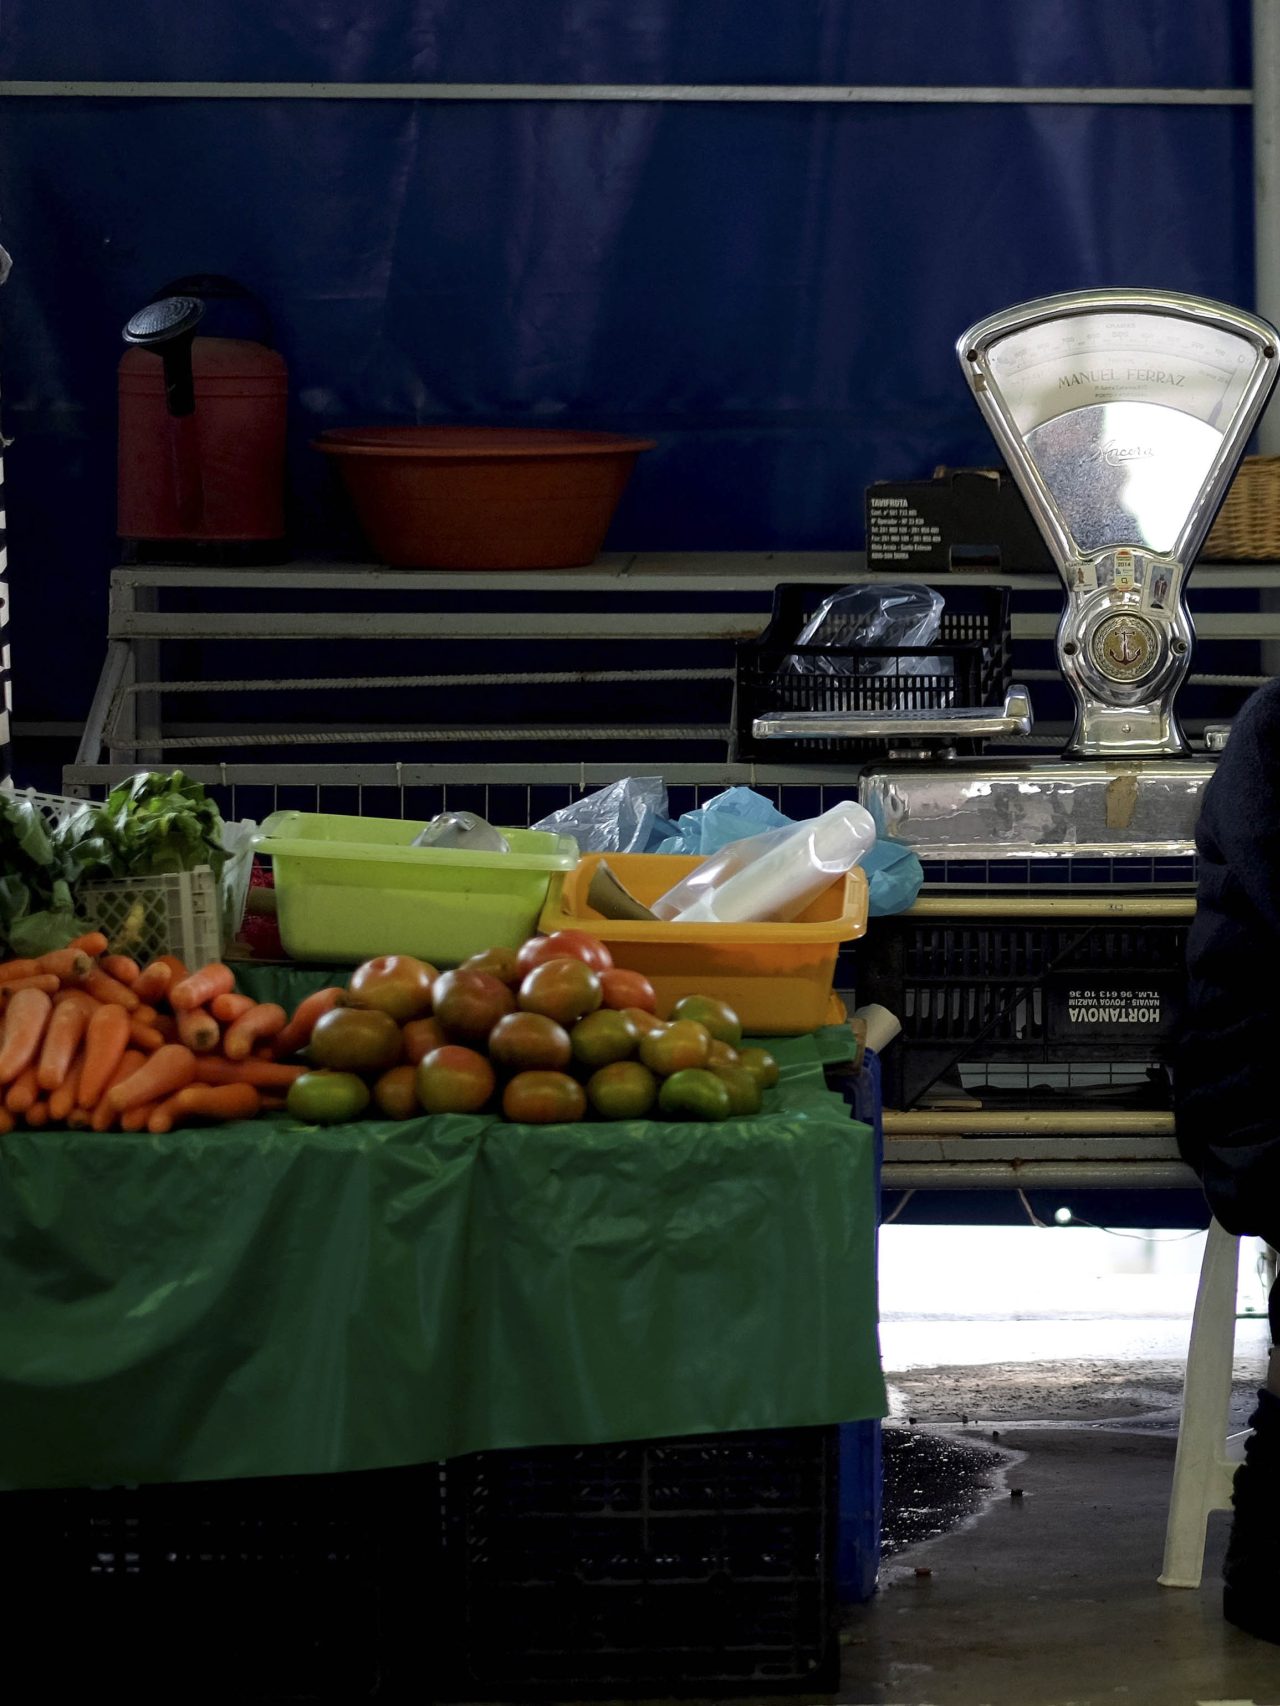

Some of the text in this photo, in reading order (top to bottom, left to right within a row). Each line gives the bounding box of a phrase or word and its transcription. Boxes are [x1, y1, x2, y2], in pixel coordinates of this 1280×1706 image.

[1058, 368, 1119, 389] MANUEL
[1126, 368, 1187, 387] FERRAZ
[1068, 1007, 1160, 1023] HORTANOVA
